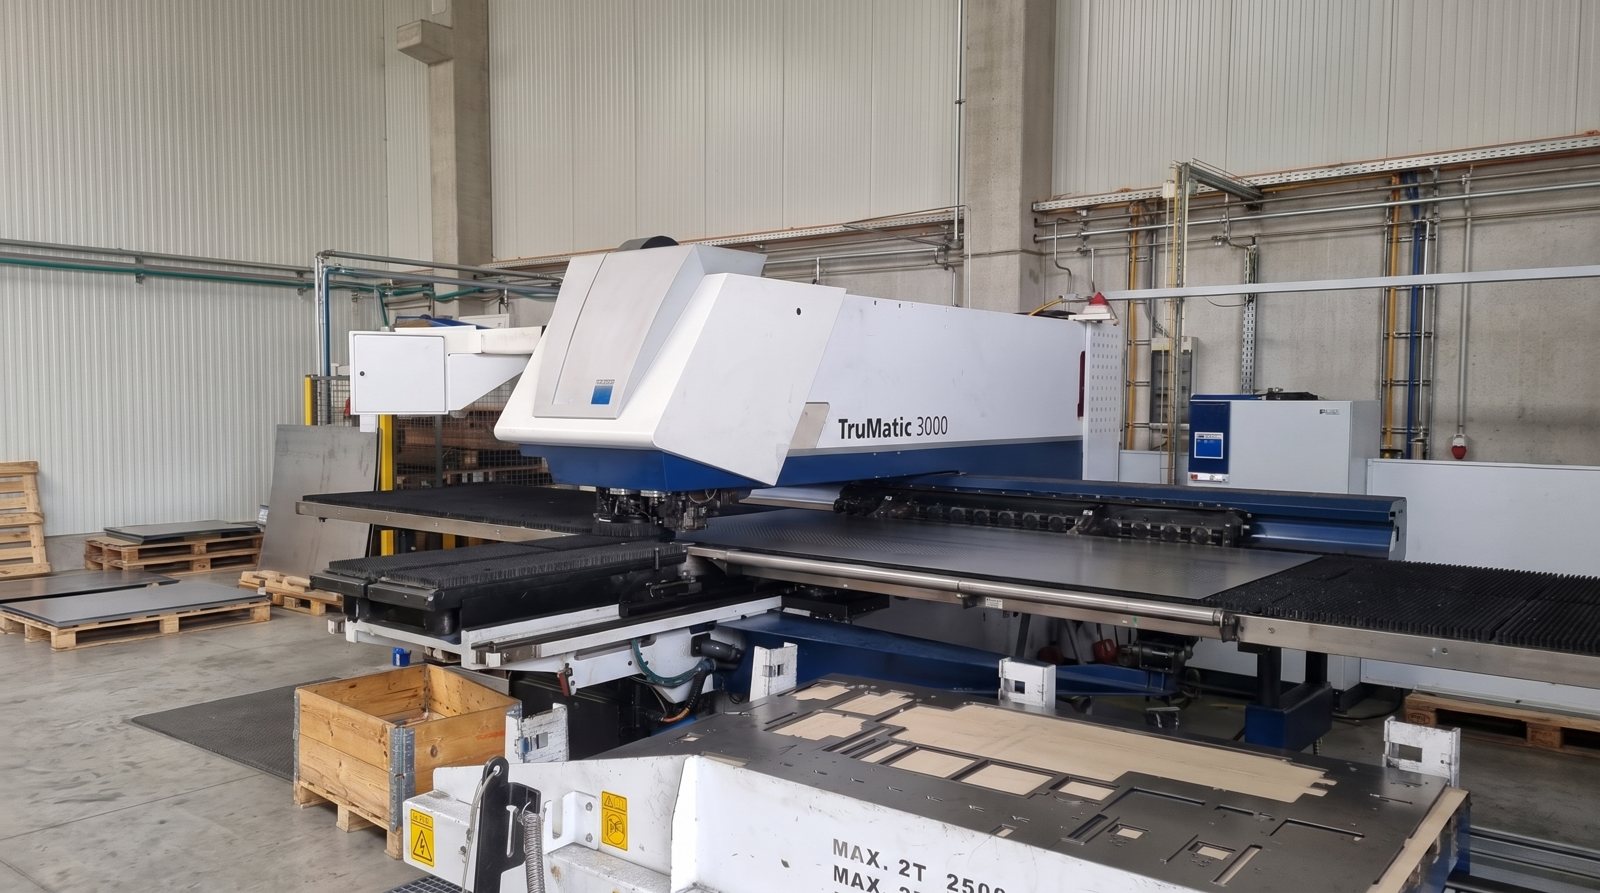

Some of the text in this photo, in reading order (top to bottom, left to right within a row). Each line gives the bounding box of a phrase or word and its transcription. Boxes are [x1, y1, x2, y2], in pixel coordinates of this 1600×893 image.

[838, 415, 948, 440] TruMatic 3000
[832, 838, 1006, 893] MAX. 2T 250
